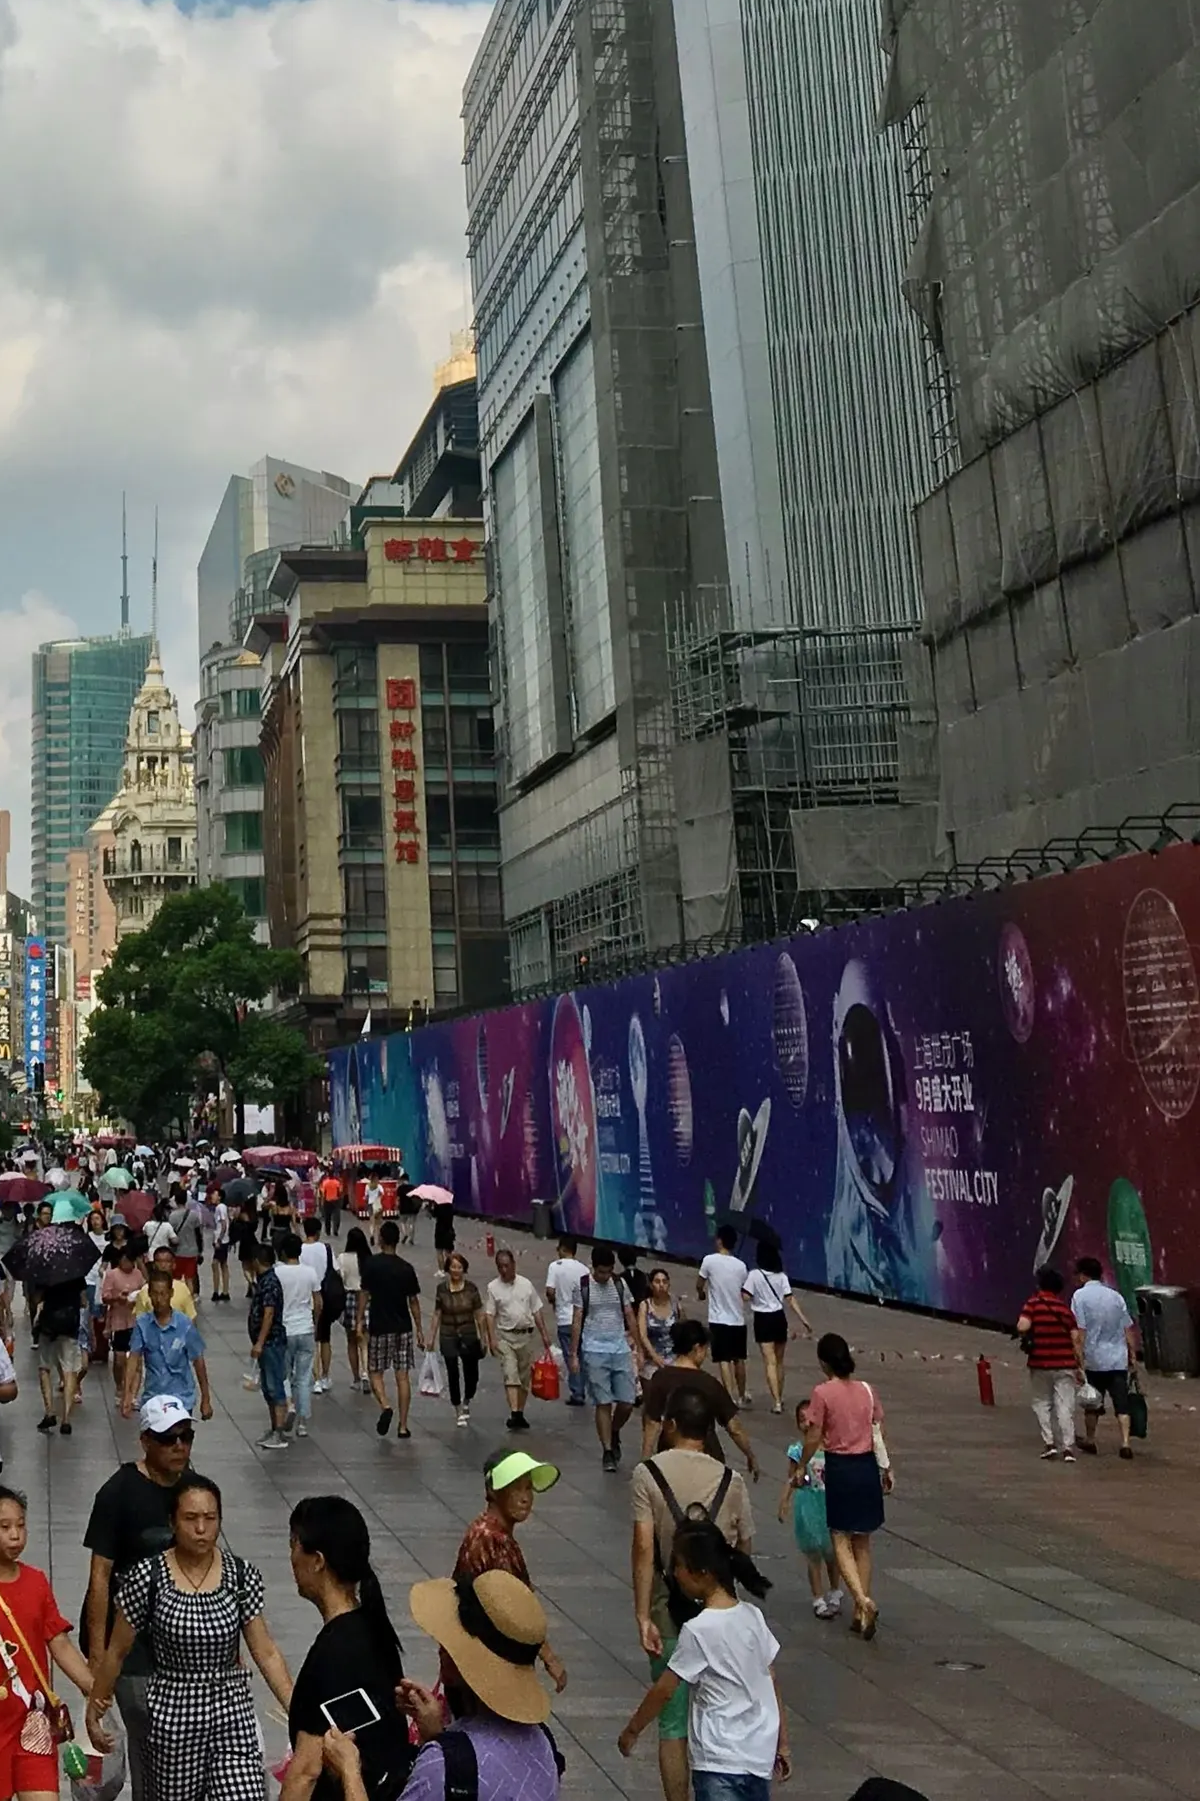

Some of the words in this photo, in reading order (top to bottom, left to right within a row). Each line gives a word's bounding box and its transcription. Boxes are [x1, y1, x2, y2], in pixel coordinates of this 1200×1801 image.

[913, 1030, 975, 1070] 上海世茂广场
[915, 1073, 975, 1113] 9月盛大开业
[920, 1126, 959, 1158] SHIMAO
[924, 1167, 974, 1203] FESTIVAL
[974, 1170, 999, 1205] CITY
